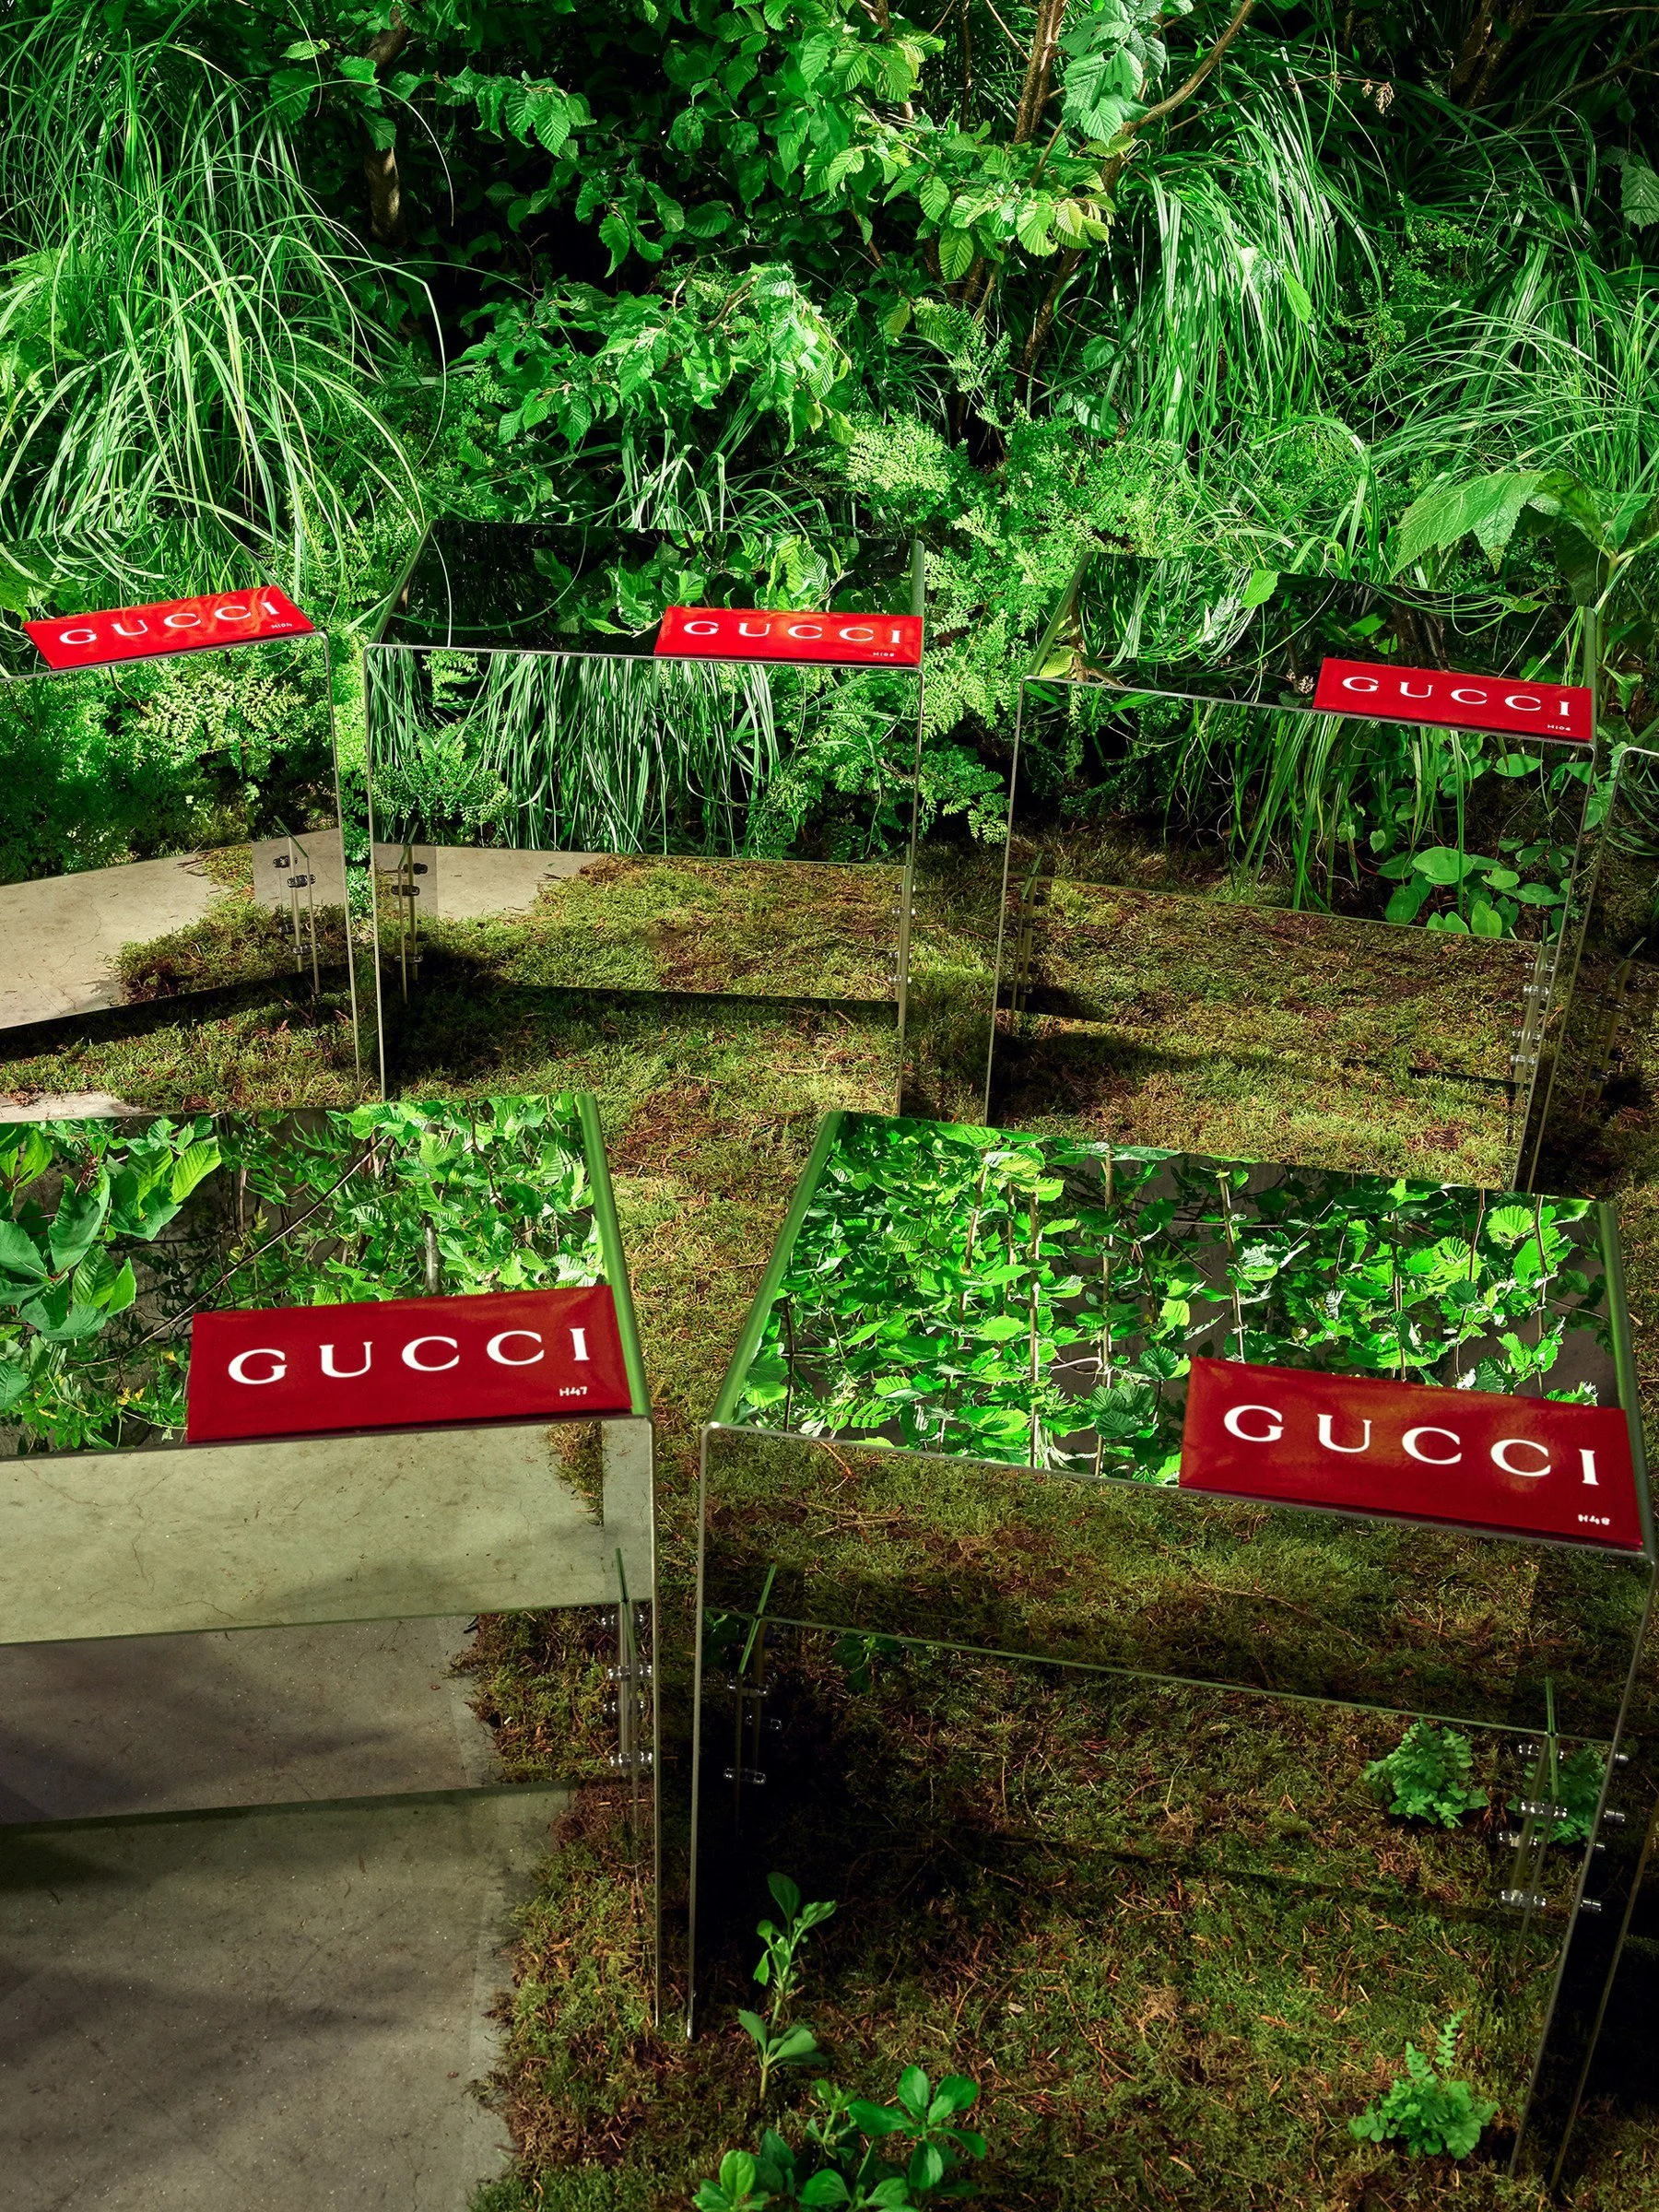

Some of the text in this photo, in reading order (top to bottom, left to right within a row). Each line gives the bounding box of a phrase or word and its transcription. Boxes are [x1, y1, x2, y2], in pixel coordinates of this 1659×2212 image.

[59, 601, 280, 645] GUCCI
[683, 620, 901, 644] GUCCI
[1342, 676, 1570, 717] GUCCI
[228, 1327, 590, 1385] GUCCI
[559, 1385, 588, 1397] H47
[1223, 1404, 1599, 1486] GUCCI
[1577, 1513, 1611, 1526] H48
